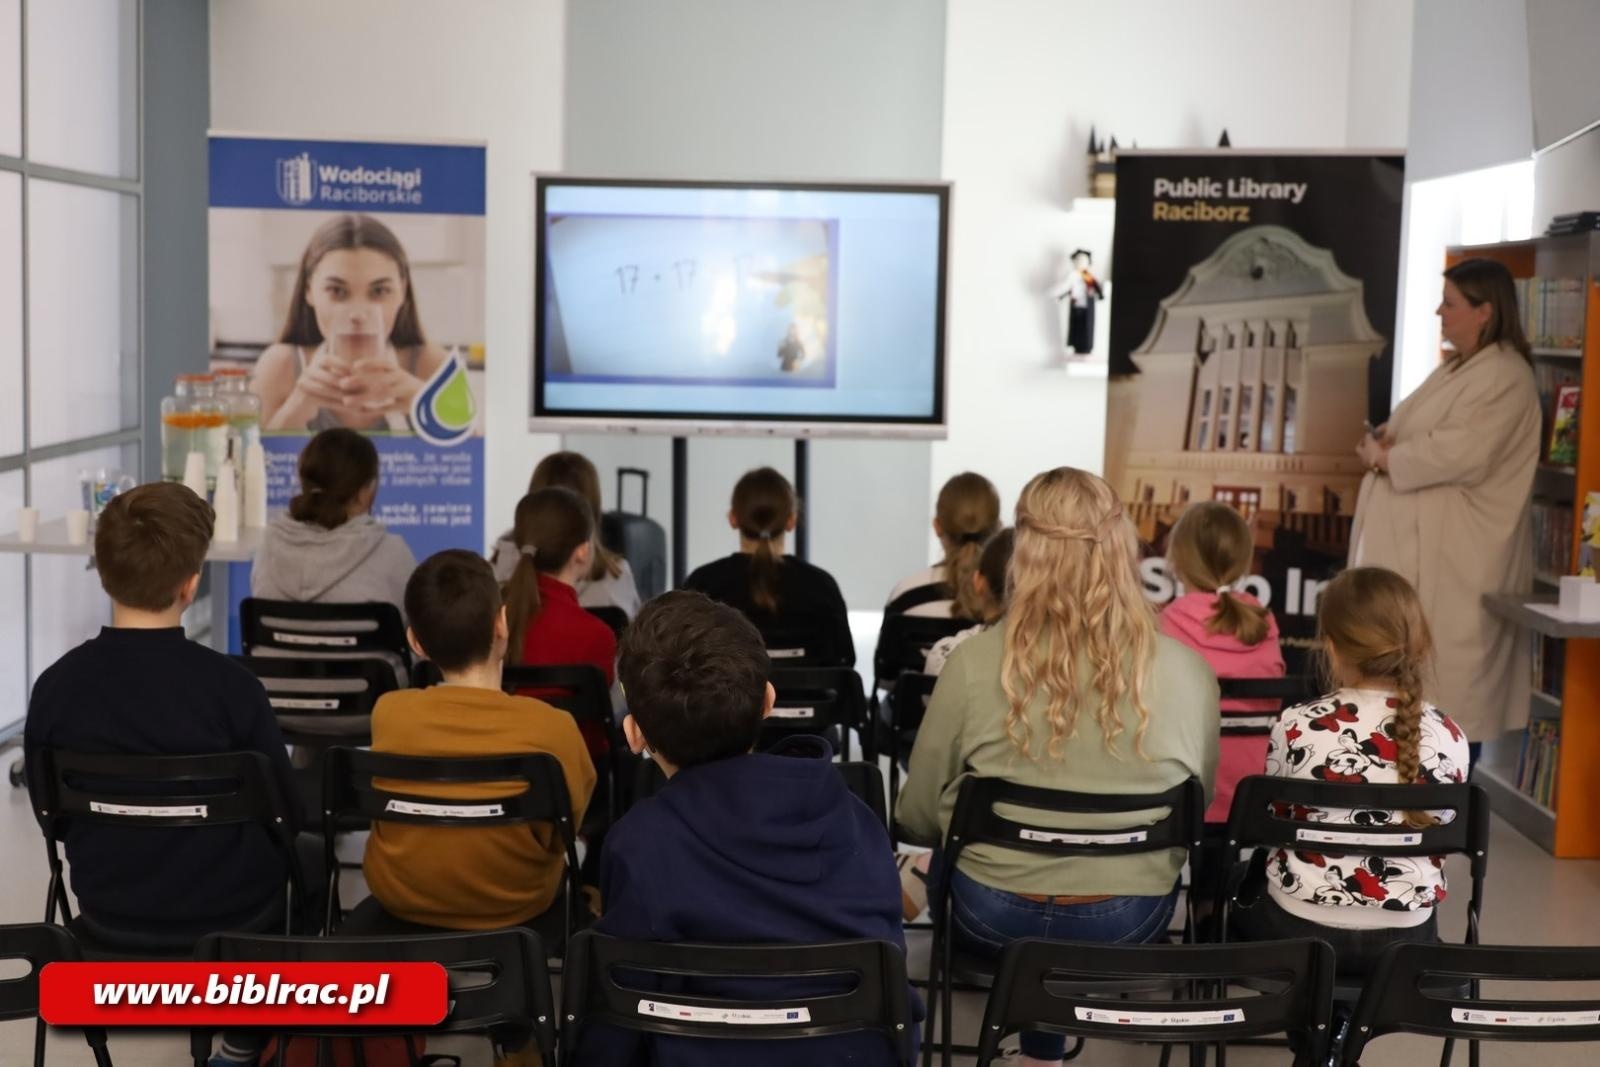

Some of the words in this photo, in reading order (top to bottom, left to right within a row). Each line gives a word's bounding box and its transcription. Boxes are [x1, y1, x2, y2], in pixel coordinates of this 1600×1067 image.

[319, 164, 421, 190] Wodociągi
[320, 185, 422, 204] Raciborskie
[1153, 177, 1222, 198] Public
[1227, 177, 1307, 204] Library
[1153, 202, 1250, 221] Raciborz
[382, 502, 416, 513] woda
[422, 502, 472, 513] zawiera
